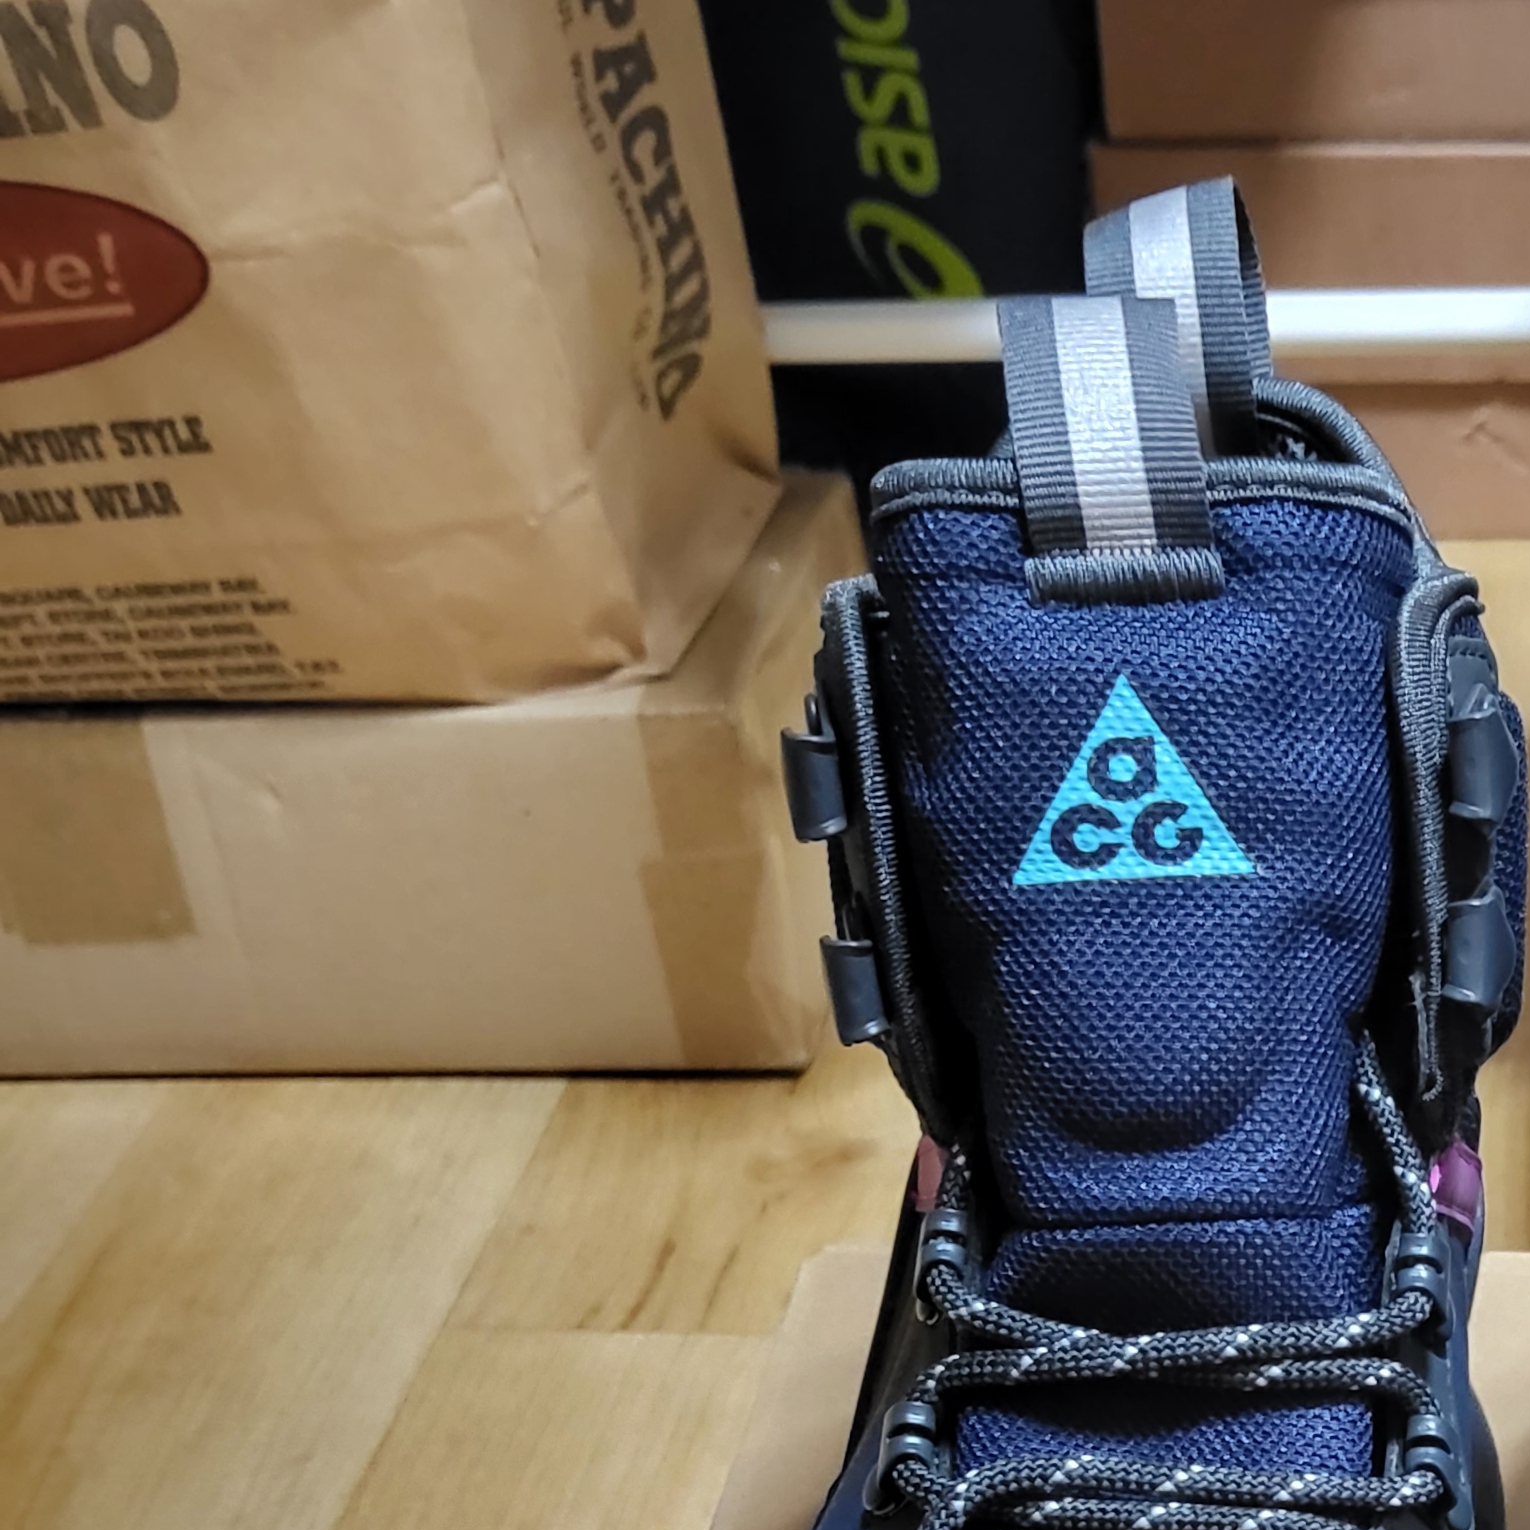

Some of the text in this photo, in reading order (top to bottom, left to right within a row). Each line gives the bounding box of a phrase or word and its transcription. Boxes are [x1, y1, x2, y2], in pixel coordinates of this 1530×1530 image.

[0, 0, 180, 138] NO
[0, 415, 213, 467] MFORT STYLE
[82, 480, 183, 522] WEAR
